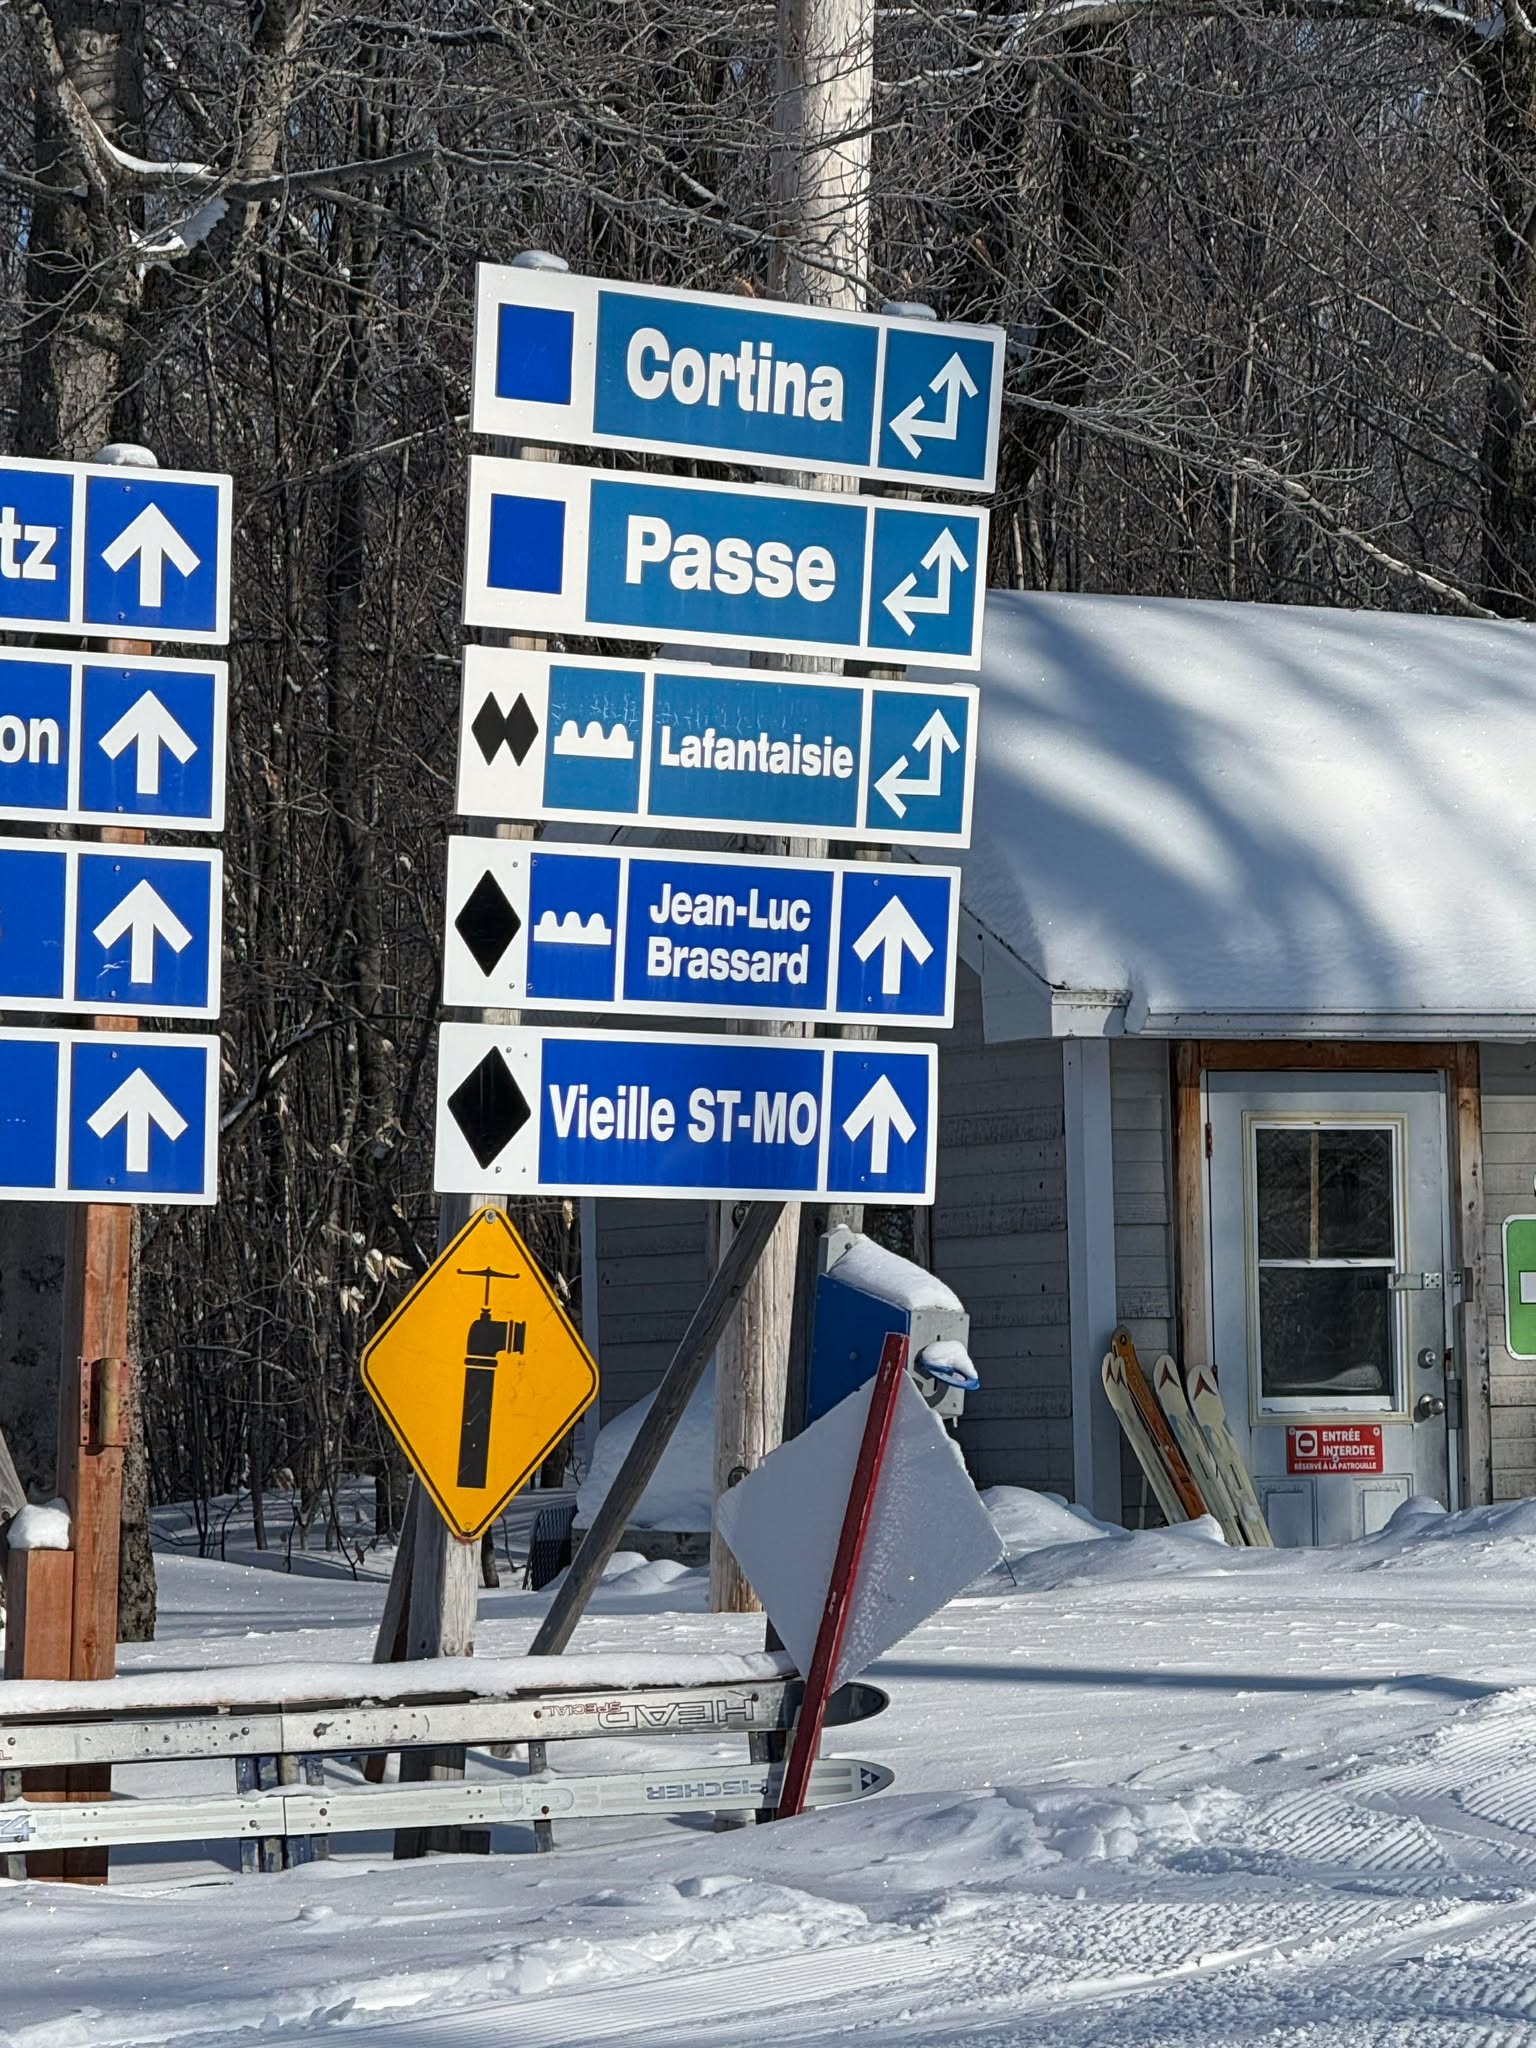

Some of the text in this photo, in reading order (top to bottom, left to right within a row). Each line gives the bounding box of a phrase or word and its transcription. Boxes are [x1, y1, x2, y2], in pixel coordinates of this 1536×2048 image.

[626, 327, 844, 422] Cortina
[625, 514, 836, 602] Passe
[660, 725, 854, 779] Lafantaisie
[649, 883, 811, 932] Jean-Luc
[646, 936, 809, 985] Brassard
[548, 1083, 818, 1147] Vieille ST-MO
[1322, 1428, 1361, 1442] ENTRÉE
[1322, 1444, 1376, 1457] INTERDITE
[1294, 1461, 1322, 1471] RÉSERVÉ
[1338, 1461, 1377, 1470] PATROUILLE
[542, 1701, 621, 1717] SPECIAL
[598, 1698, 754, 1729] HEAD
[646, 1778, 767, 1801] FISCHER
